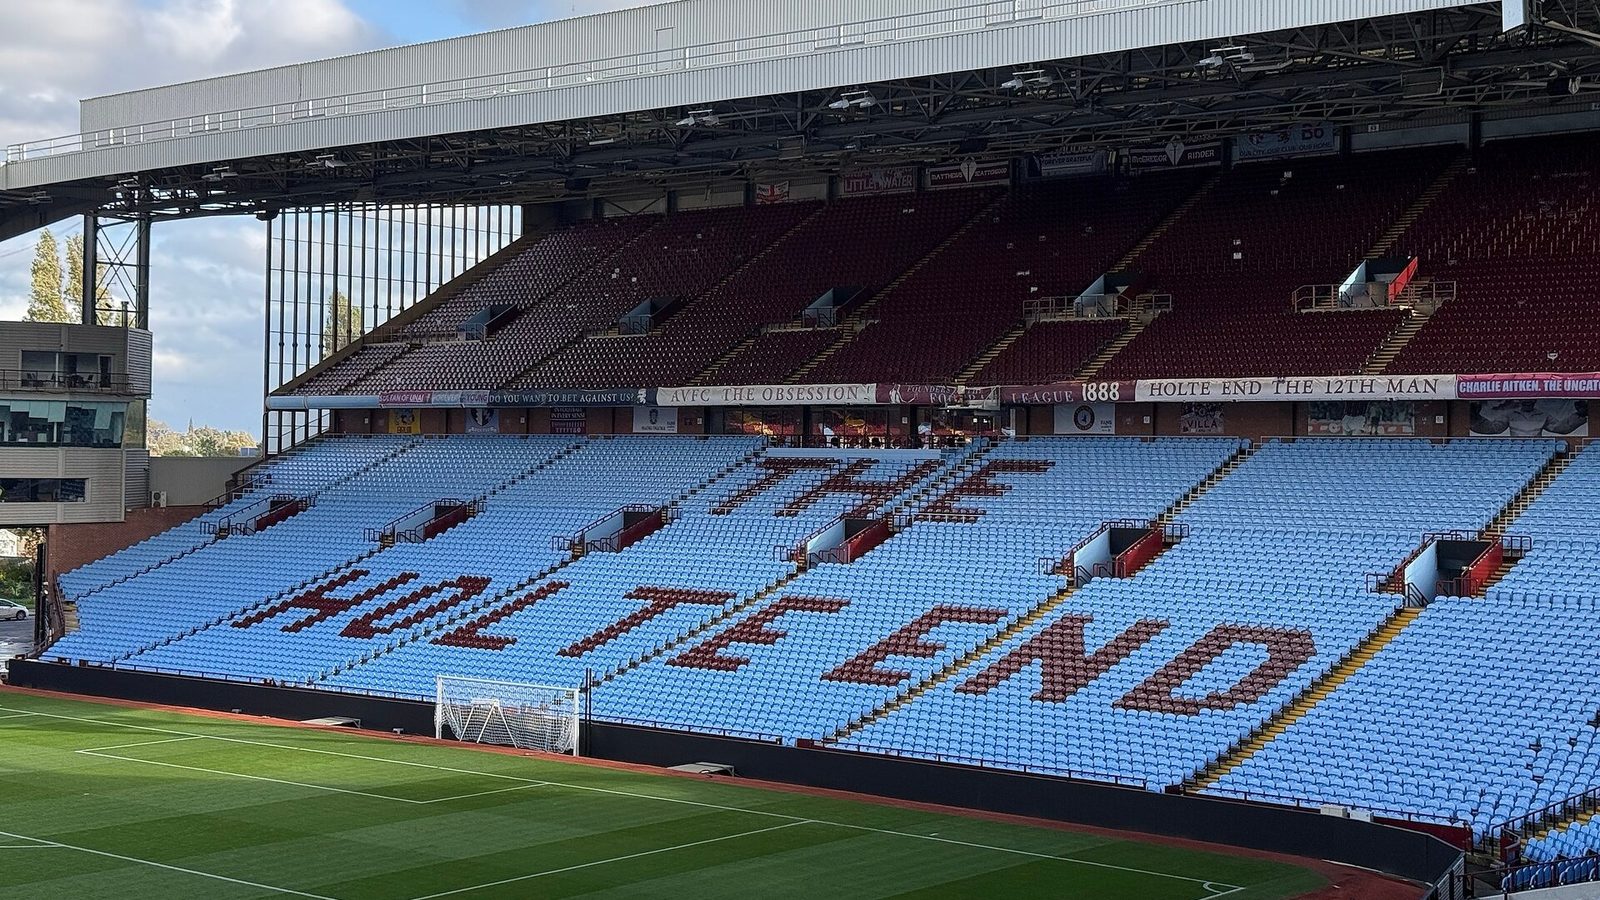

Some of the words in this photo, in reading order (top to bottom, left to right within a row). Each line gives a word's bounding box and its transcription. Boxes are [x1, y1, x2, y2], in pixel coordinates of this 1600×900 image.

[671, 388, 712, 403] AVFC
[722, 388, 761, 402] THE
[762, 385, 860, 402] OBSESSION
[1010, 390, 1074, 404] LEAGUE
[1081, 381, 1120, 402] 1888
[1149, 381, 1211, 396] HOLTE
[1221, 380, 1262, 395] END
[1271, 378, 1314, 395] THE
[1325, 378, 1377, 394] 12TH
[1386, 377, 1439, 393] MAN
[1459, 380, 1501, 393] CHARLIE
[1502, 379, 1541, 392] AITKEN.
[1543, 379, 1566, 392] THE
[1563, 379, 1600, 392] UNCAT
[490, 394, 501, 403] DO
[503, 393, 520, 403] YOU
[522, 393, 546, 402] WANT
[547, 393, 560, 402] TO
[562, 393, 578, 402] BET
[580, 392, 617, 402] AGAINST
[1187, 420, 1218, 429] VILLA
[710, 457, 1055, 523] THE
[230, 569, 851, 671] HOLTE
[820, 603, 1317, 716] END
